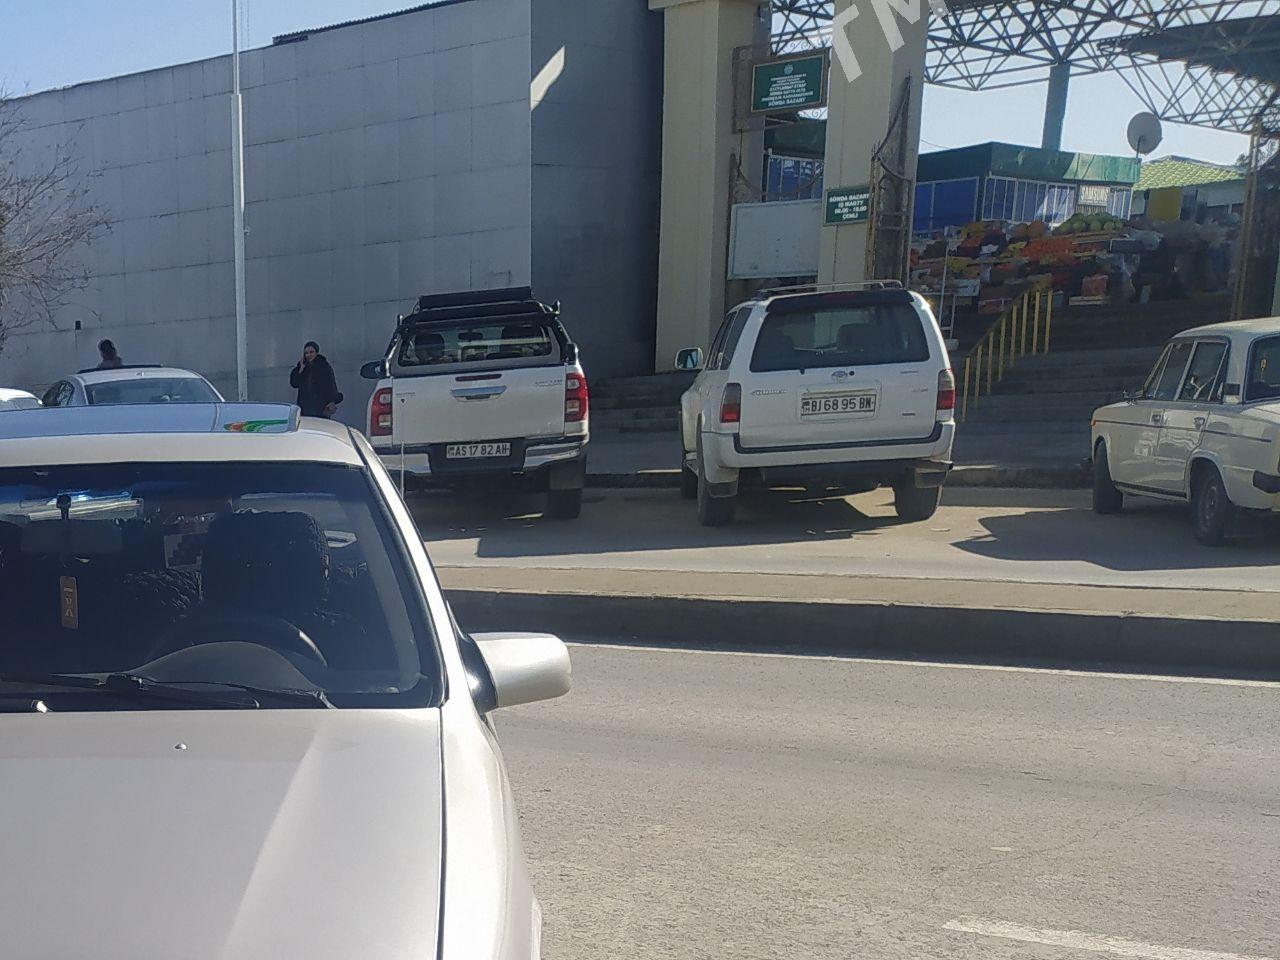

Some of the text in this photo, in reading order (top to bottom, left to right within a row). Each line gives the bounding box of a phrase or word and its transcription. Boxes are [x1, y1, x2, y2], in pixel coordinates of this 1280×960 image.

[811, 400, 822, 412] BJ
[824, 399, 839, 411] 68
[841, 398, 856, 410] 95
[455, 446, 467, 456] AS
[469, 445, 478, 456] 17
[481, 445, 494, 455] 82
